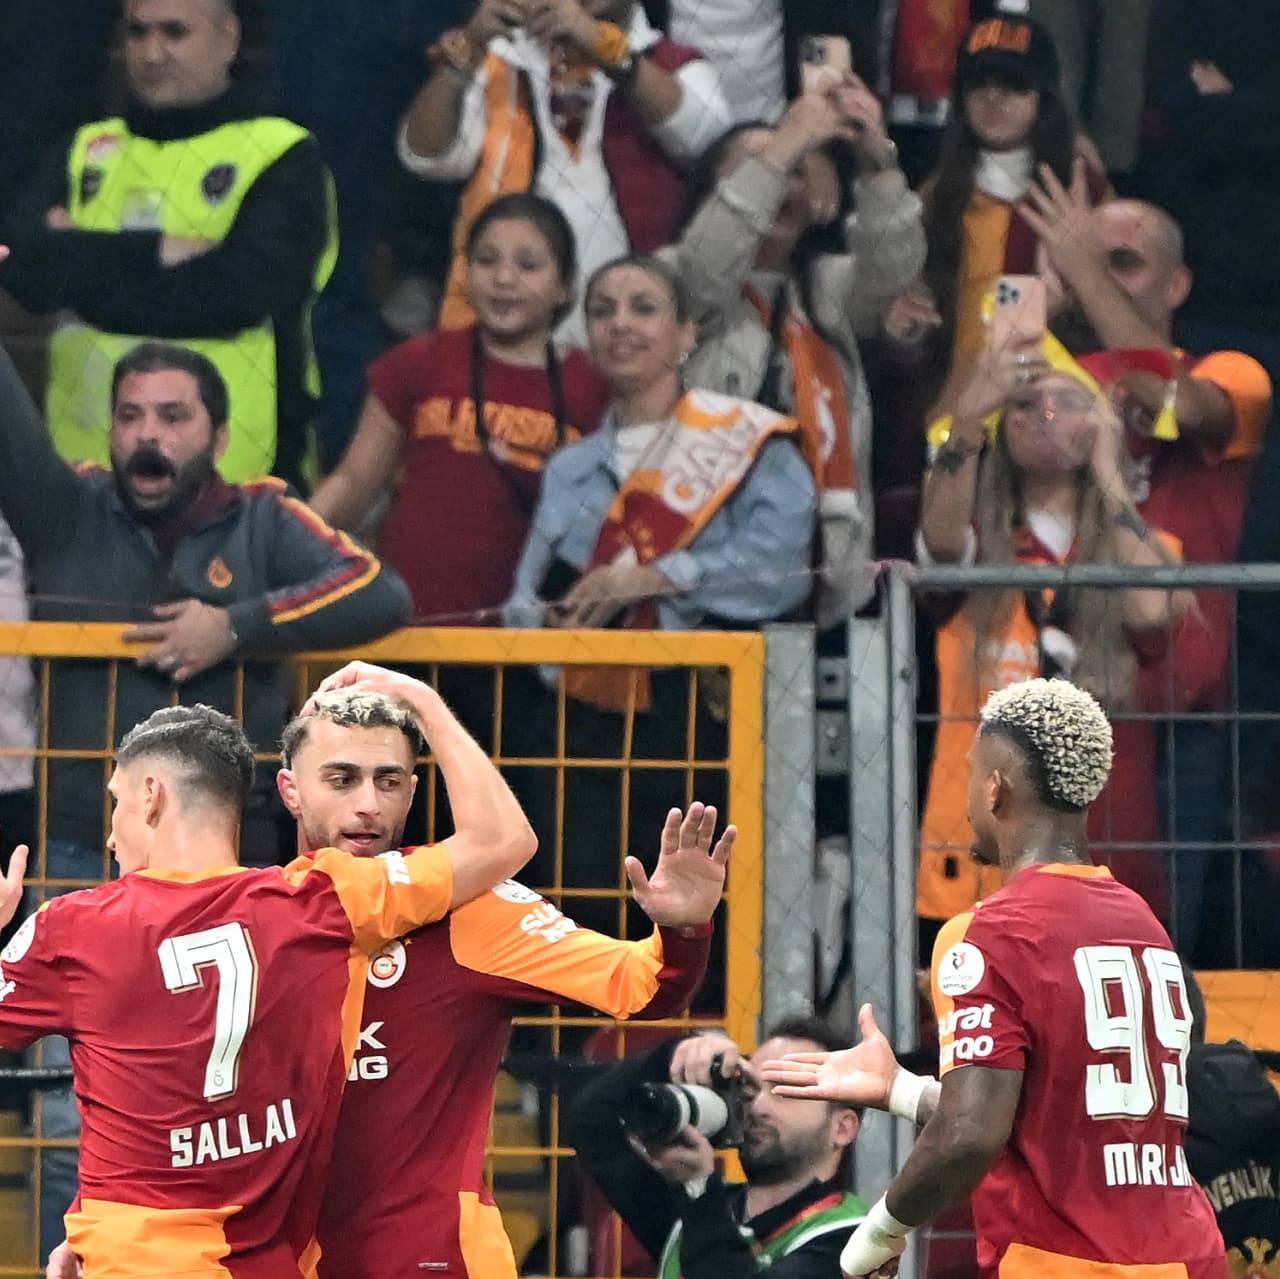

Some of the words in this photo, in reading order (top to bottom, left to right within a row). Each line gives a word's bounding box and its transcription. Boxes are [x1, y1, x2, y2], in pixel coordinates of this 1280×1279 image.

[157, 921, 259, 1103] 7
[1072, 944, 1195, 1122] 99
[169, 1098, 298, 1168] SALLAI
